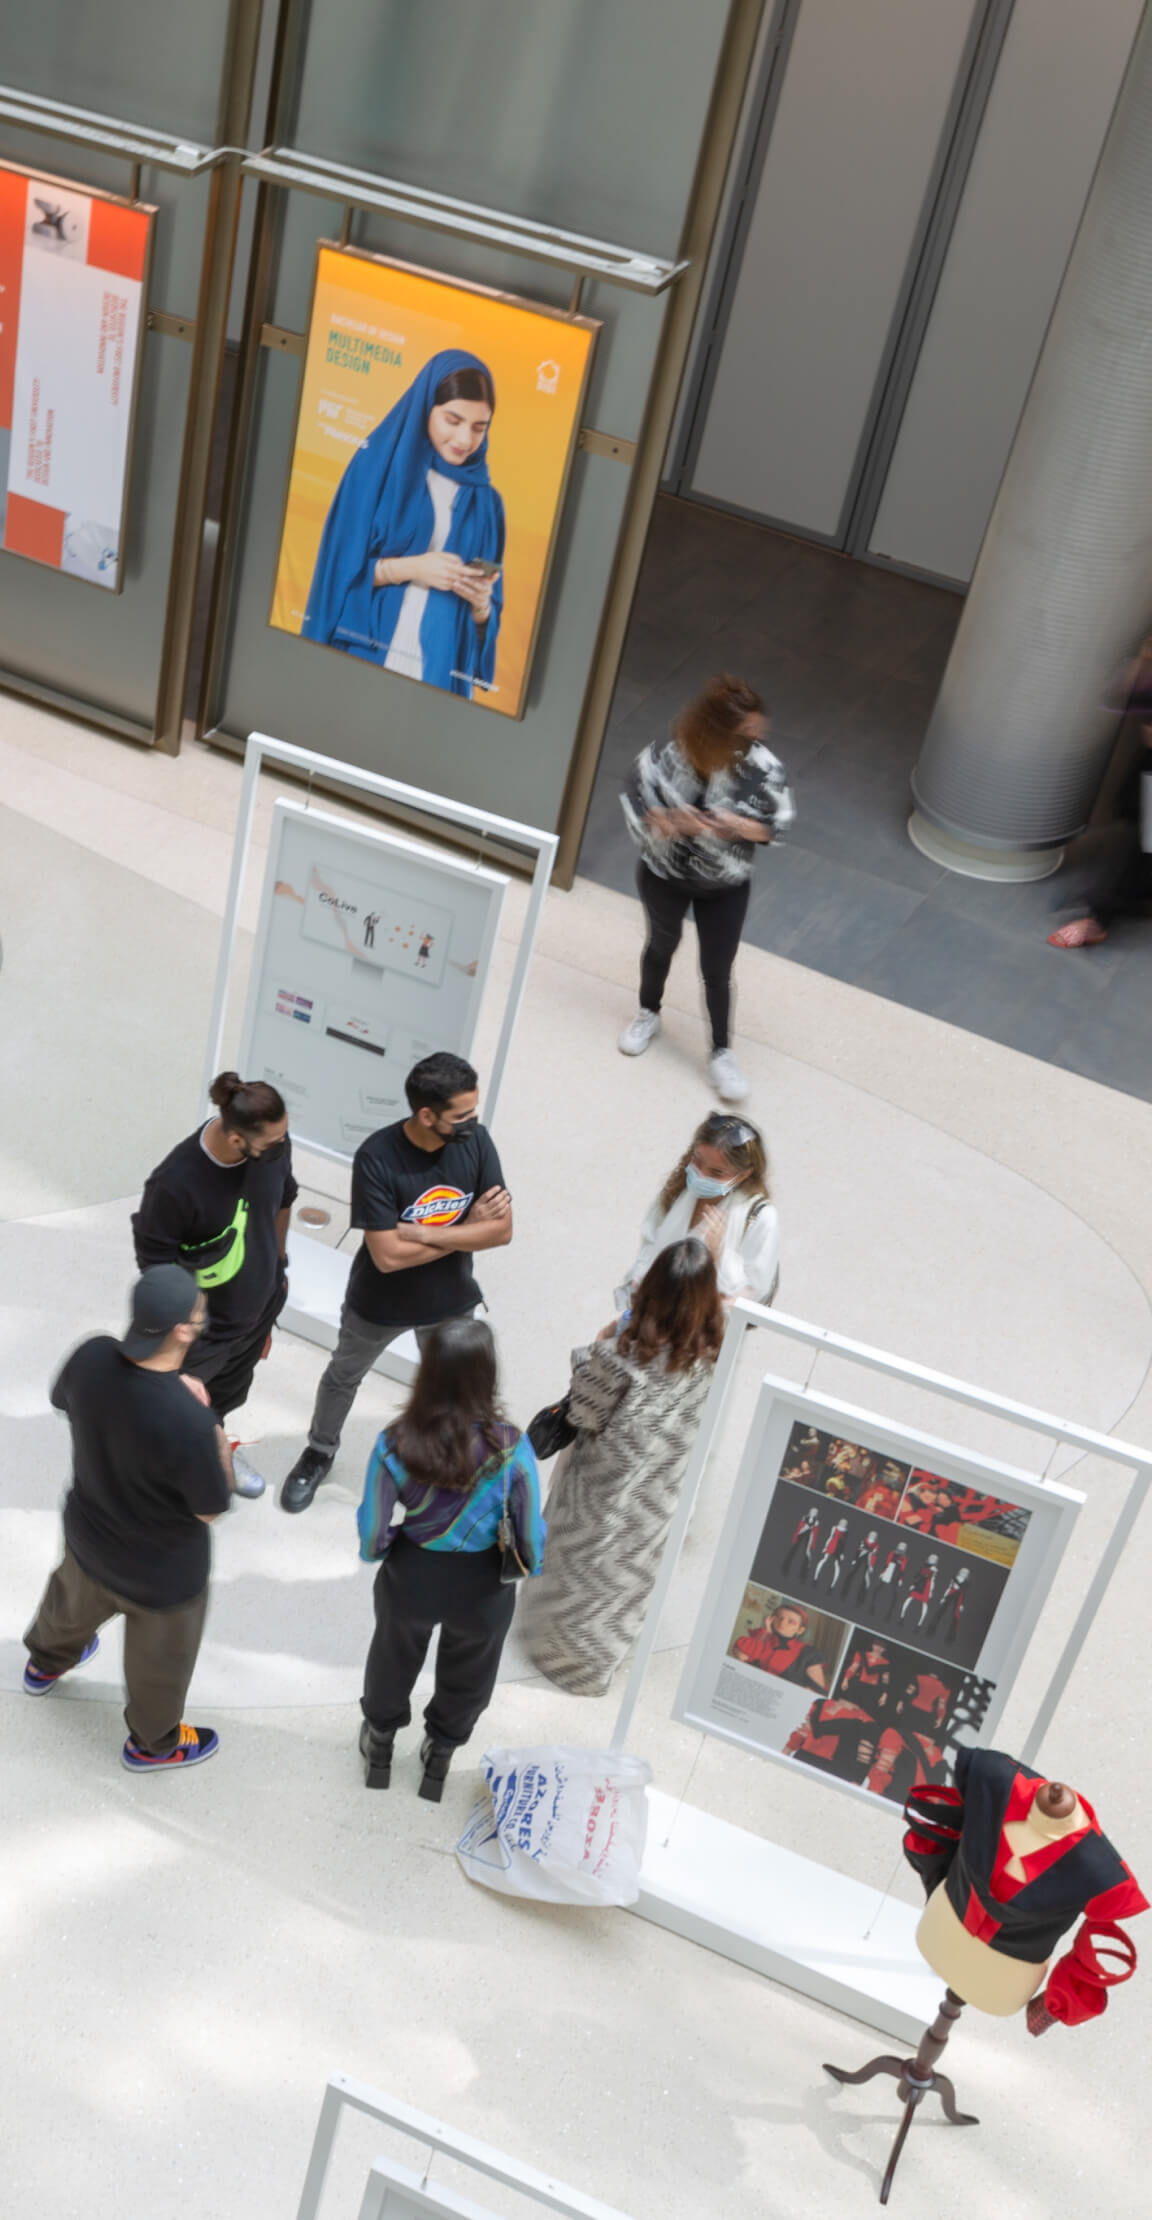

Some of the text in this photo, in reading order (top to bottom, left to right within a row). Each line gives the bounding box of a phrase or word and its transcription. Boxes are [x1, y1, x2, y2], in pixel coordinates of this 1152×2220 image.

[326, 347, 371, 375] DESIGN
[328, 330, 403, 368] MULTIMEDIA
[411, 1199, 466, 1217] Dickies
[518, 1773, 547, 1851] AZORES
